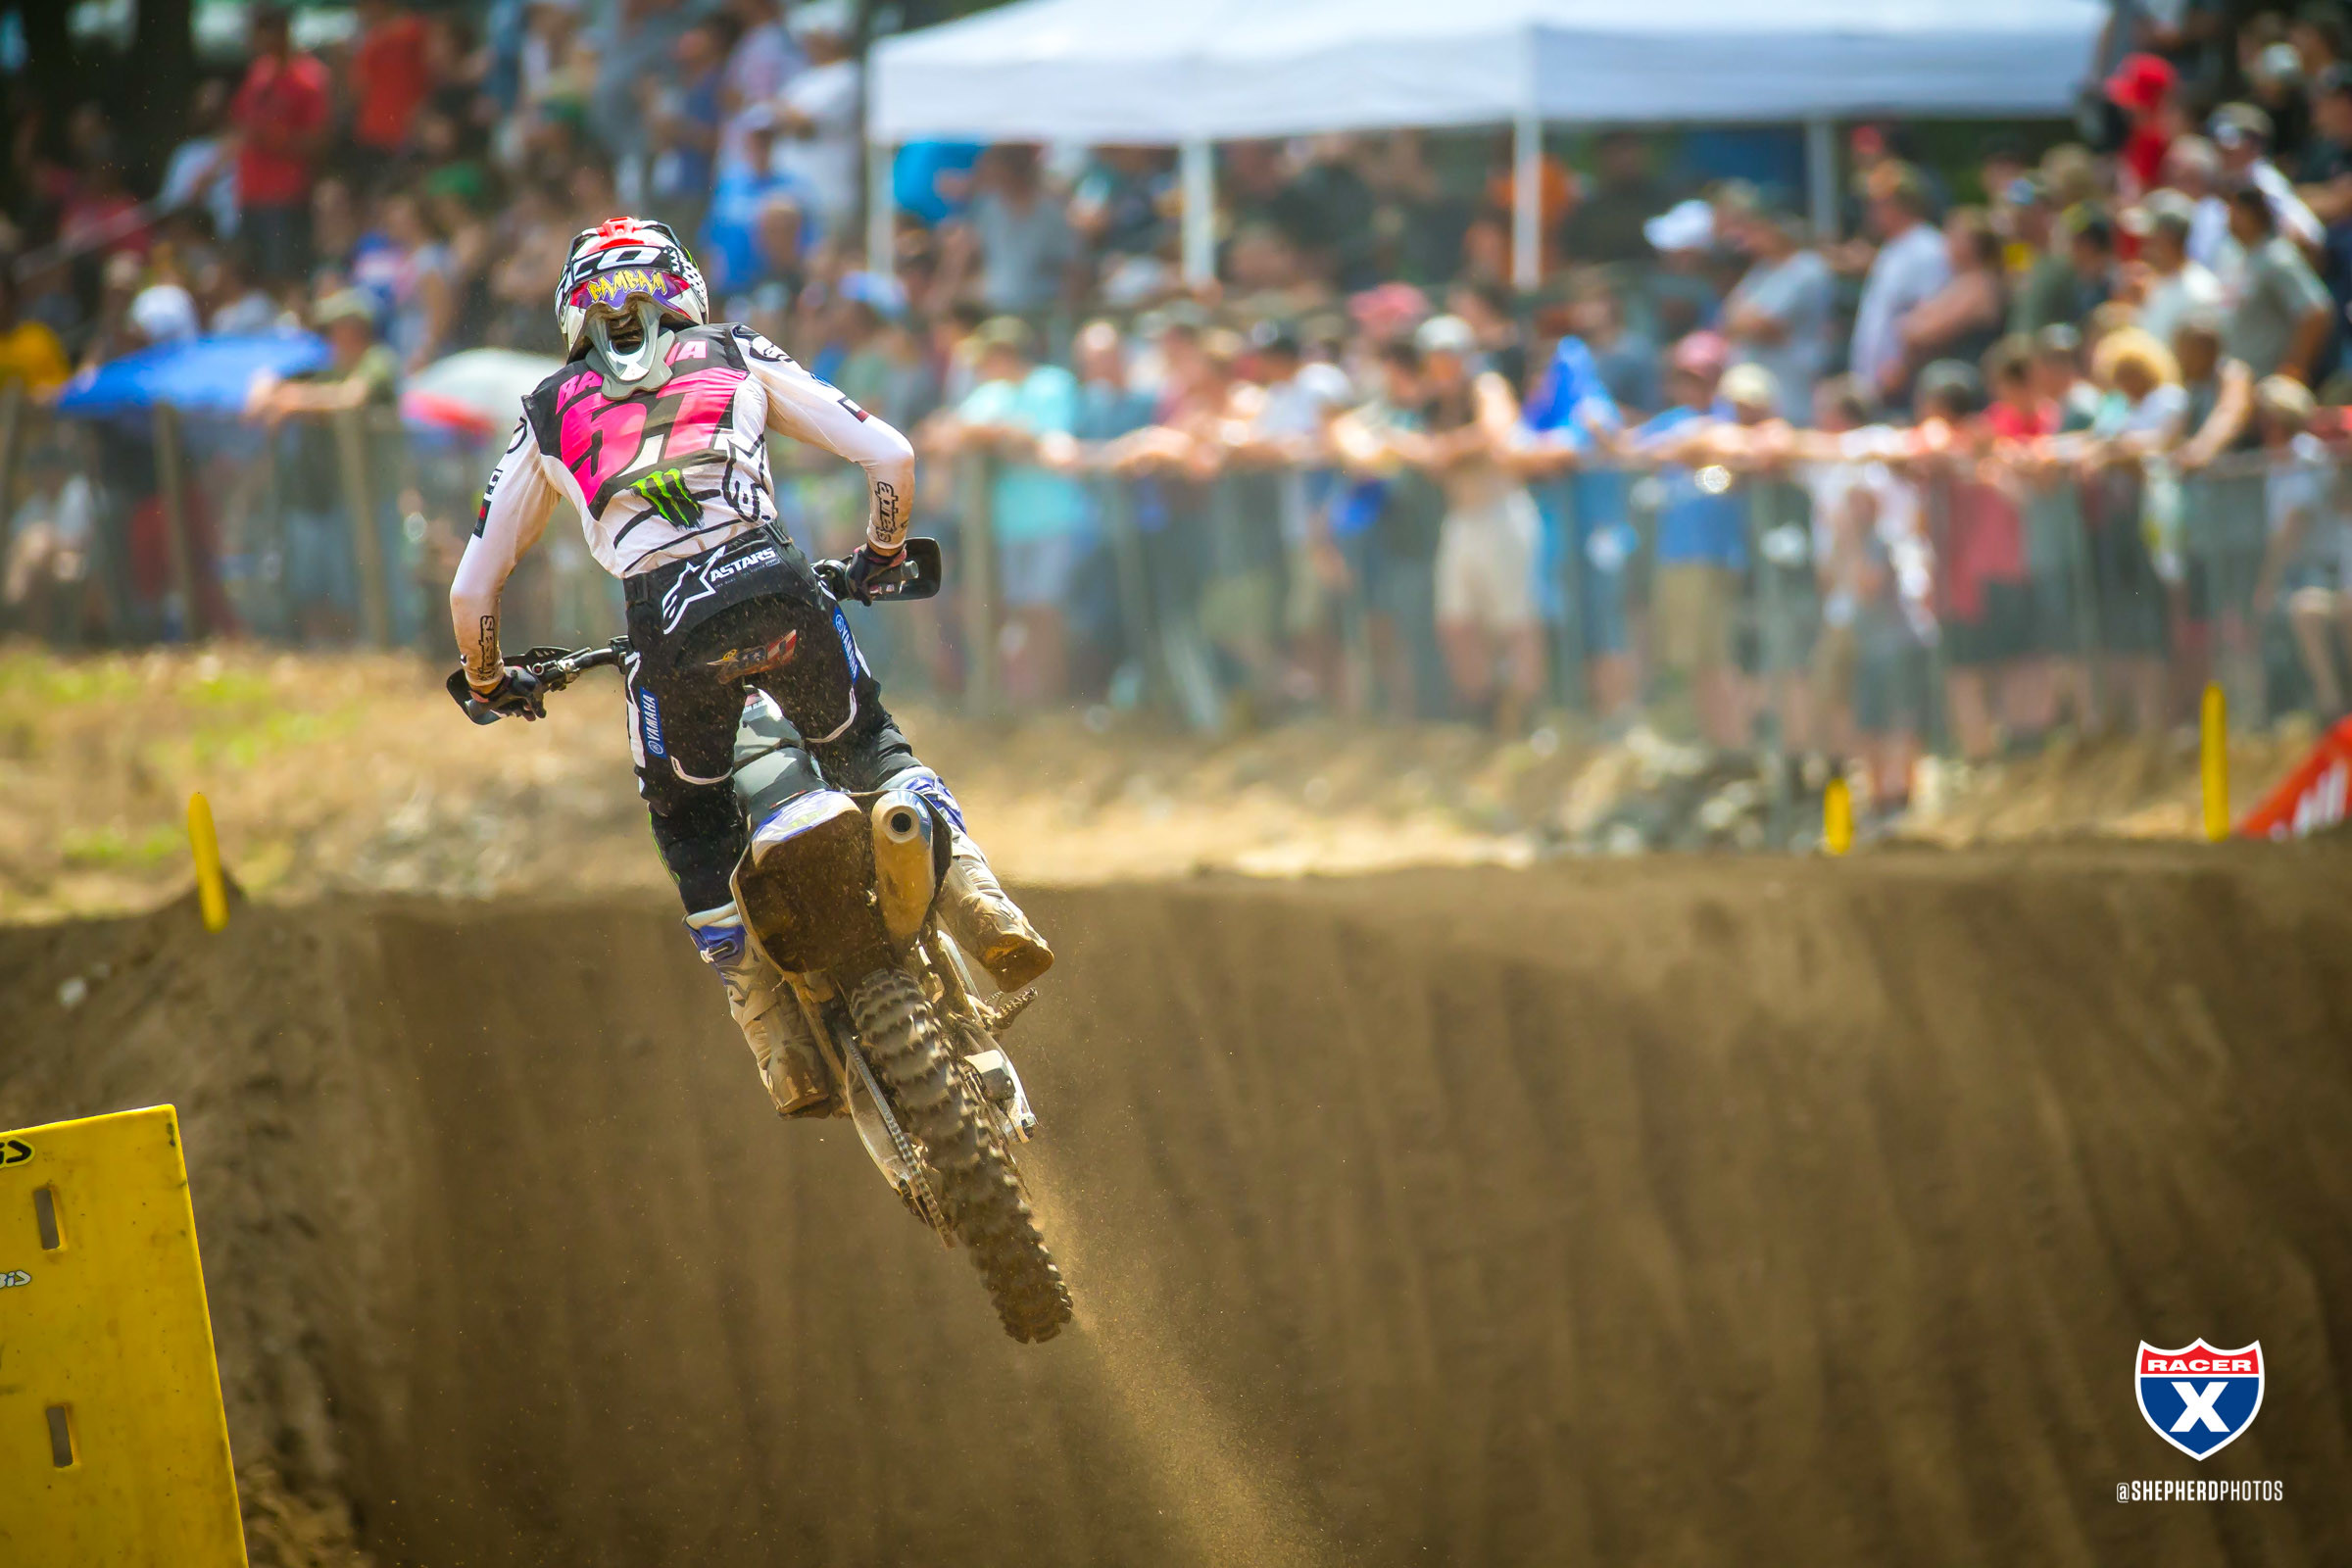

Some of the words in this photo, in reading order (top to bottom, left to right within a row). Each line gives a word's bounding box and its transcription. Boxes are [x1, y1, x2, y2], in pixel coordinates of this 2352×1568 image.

[588, 269, 667, 303] BAMBAM
[556, 340, 707, 415] BAIA
[561, 368, 748, 506] 51
[710, 547, 776, 582] ASTARS
[842, 625, 858, 678] YAMAHA
[642, 694, 661, 741] YAMAHA
